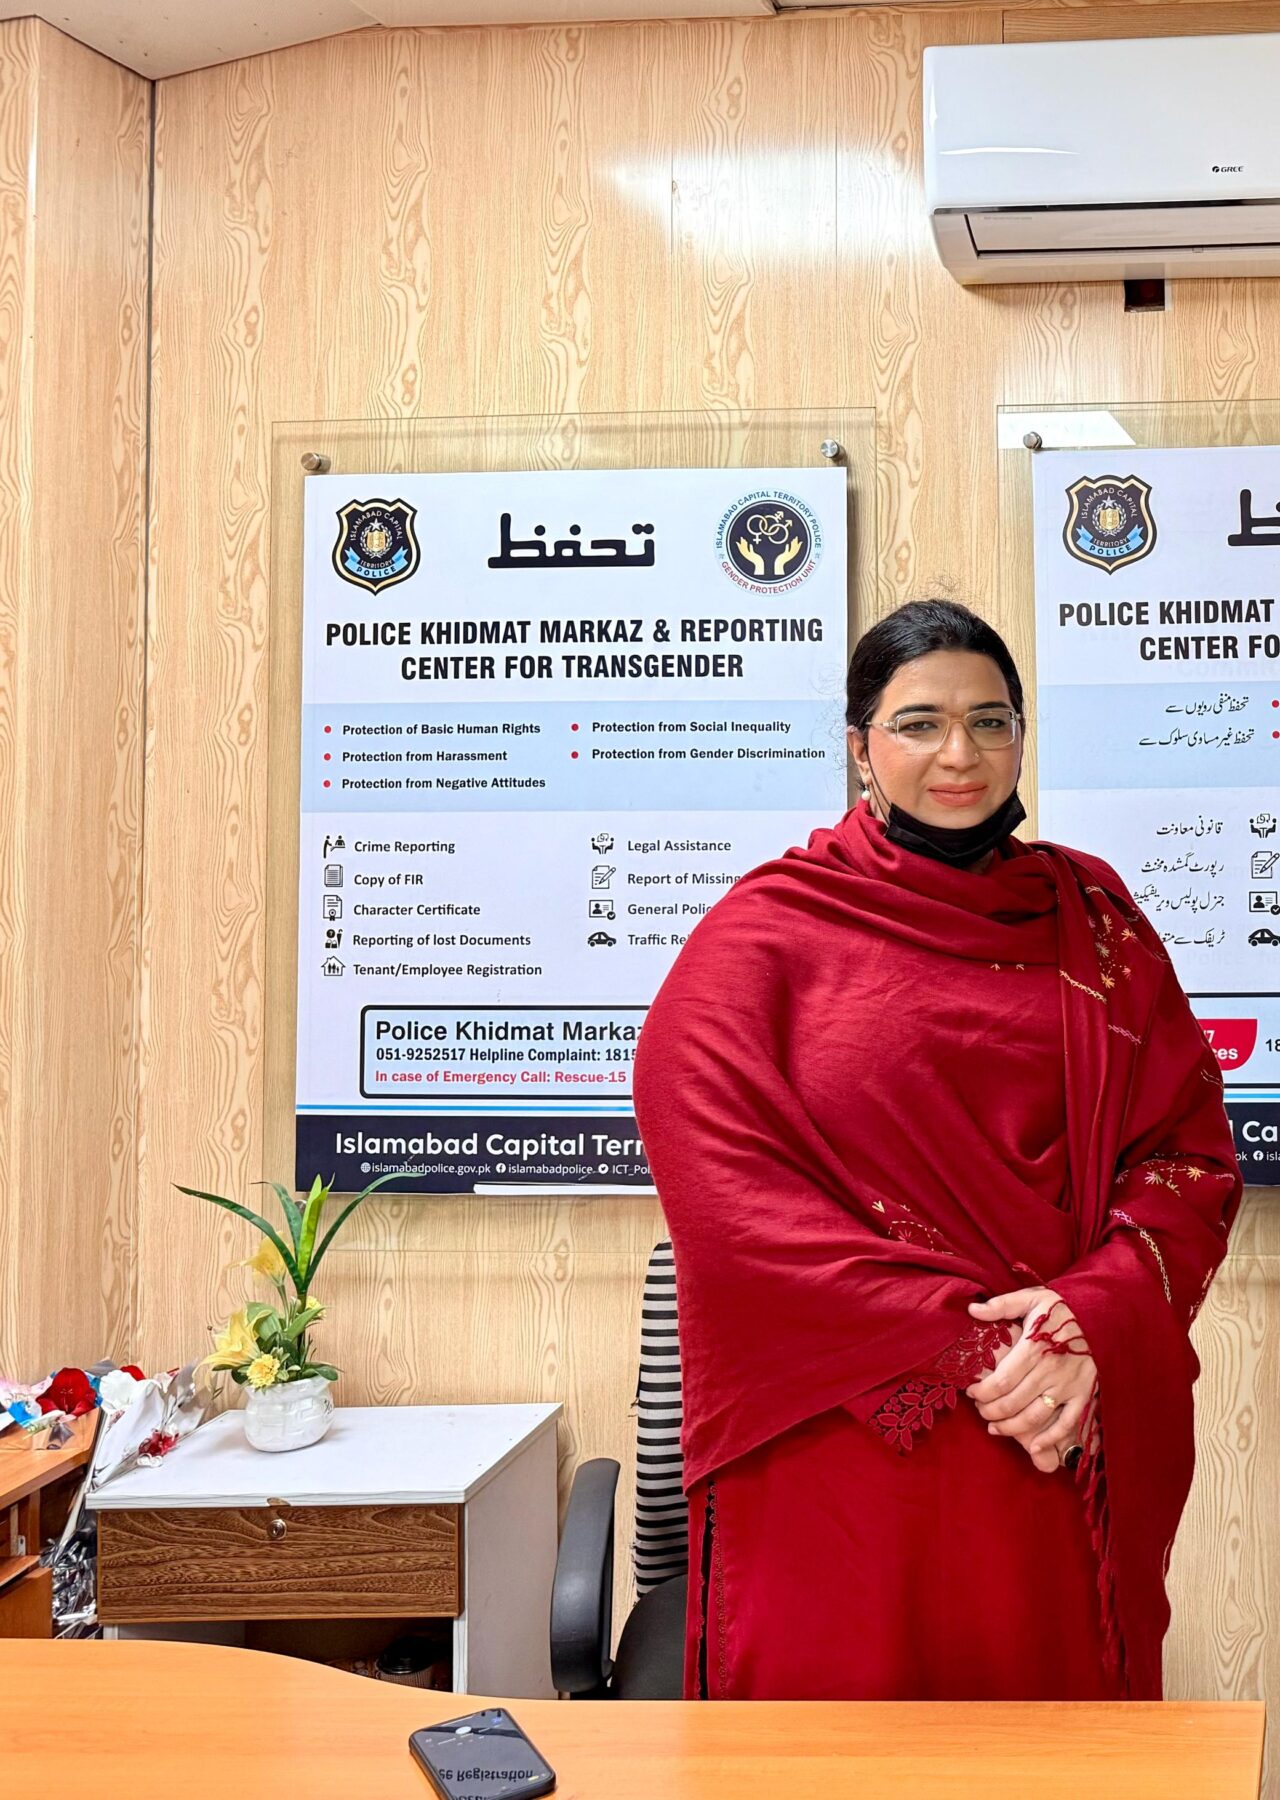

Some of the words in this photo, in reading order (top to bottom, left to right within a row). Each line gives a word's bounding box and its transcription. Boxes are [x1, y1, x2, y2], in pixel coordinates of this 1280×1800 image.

[1082, 488, 1115, 519] ISLAMABAD
[1117, 490, 1137, 518] CAPITAL
[350, 510, 382, 541] ISLAMABAD
[716, 504, 738, 548] ISLAMABAD
[738, 491, 771, 506] CAPITAL
[773, 491, 813, 518] TERRITORY
[810, 518, 822, 548] POLICE
[487, 512, 656, 568] تحفظ
[1093, 538, 1128, 548] TERRITORY
[1089, 544, 1132, 556] POLICE
[356, 566, 396, 577] POLICE
[721, 561, 749, 589] GENDER
[749, 576, 803, 594] PROTECTION
[801, 559, 816, 577] UNIT
[1060, 602, 1149, 626] POLICE
[1160, 599, 1274, 624] KHIDMAT
[327, 623, 410, 646] POLICE
[421, 621, 531, 644] KHIDMAT
[541, 620, 643, 643] MARKAZ
[653, 619, 670, 642] &
[681, 619, 822, 642] REPORTING
[1140, 636, 1238, 660] CENTER
[402, 657, 495, 680] CENTER
[505, 656, 552, 678] FOR
[562, 655, 743, 678] TRANSGENDER
[1165, 704, 1184, 713] سے
[1185, 700, 1212, 716] رویوں
[1213, 692, 1231, 714] منفی
[1228, 696, 1249, 712] تحفظ
[342, 724, 403, 736] Protection
[406, 723, 418, 735] of
[421, 723, 454, 735] Basic
[457, 723, 499, 734] Human
[502, 723, 541, 736] Rights
[592, 721, 655, 733] Protection
[658, 721, 687, 732] from
[689, 721, 728, 732] Social
[731, 721, 791, 734] Inequality
[1138, 738, 1157, 746] سے
[1158, 727, 1188, 745] سلوک
[1187, 730, 1219, 747] مساوی
[1216, 727, 1233, 748] غیر
[1234, 728, 1255, 744] تحفظ
[342, 751, 403, 762] Protection
[405, 750, 433, 762] from
[436, 750, 508, 762] Harassment
[592, 748, 655, 760] Protection
[658, 748, 687, 759] from
[689, 748, 734, 759] Gender
[737, 747, 826, 759] Discrimination
[342, 778, 402, 789] Protection
[405, 777, 433, 789] from
[436, 777, 488, 791] Negative
[490, 777, 546, 788] Attitudes
[1156, 822, 1194, 835] معاونت
[1194, 815, 1223, 837] قانونی
[354, 840, 391, 853] Crime
[394, 840, 456, 855] Reporting
[627, 839, 661, 854] Legal
[663, 839, 732, 851] Assistance
[1141, 858, 1164, 873] مخنث
[1162, 851, 1195, 873] گمشدہ
[1188, 859, 1225, 878] رپورٹ
[353, 874, 385, 888] Copy
[388, 873, 402, 885] of
[404, 874, 424, 885] FIR
[627, 873, 672, 887] Report
[674, 872, 689, 885] of
[1170, 887, 1199, 914] پولیس
[1199, 890, 1225, 911] جنرل
[353, 903, 414, 916] Character
[416, 903, 481, 916] Certificate
[627, 903, 678, 915] General
[352, 934, 414, 948] Reporting
[416, 933, 431, 946] of
[433, 933, 457, 946] lost
[459, 934, 531, 946] Documents
[627, 933, 667, 946] Traffic
[1174, 936, 1192, 944] سے
[1193, 927, 1226, 948] ٹریفک
[352, 962, 463, 978] Tenant/Employee
[466, 963, 542, 978] Registration
[376, 1020, 448, 1041] Police
[455, 1020, 555, 1041] Khidmat
[376, 1047, 466, 1061] 051-9252517
[469, 1047, 525, 1064] Helpline
[527, 1048, 601, 1064] Complaint:
[375, 1070, 388, 1082] In
[391, 1072, 423, 1082] case
[426, 1070, 440, 1082] of
[443, 1070, 517, 1085] Emergency
[520, 1070, 551, 1083] Call:
[554, 1071, 627, 1083] Rescue-15
[337, 1132, 477, 1154] Islamabad
[486, 1134, 583, 1159] Capital
[371, 1162, 492, 1177] islamabadpolice.gov.pk
[507, 1163, 593, 1177] islamabadpolice
